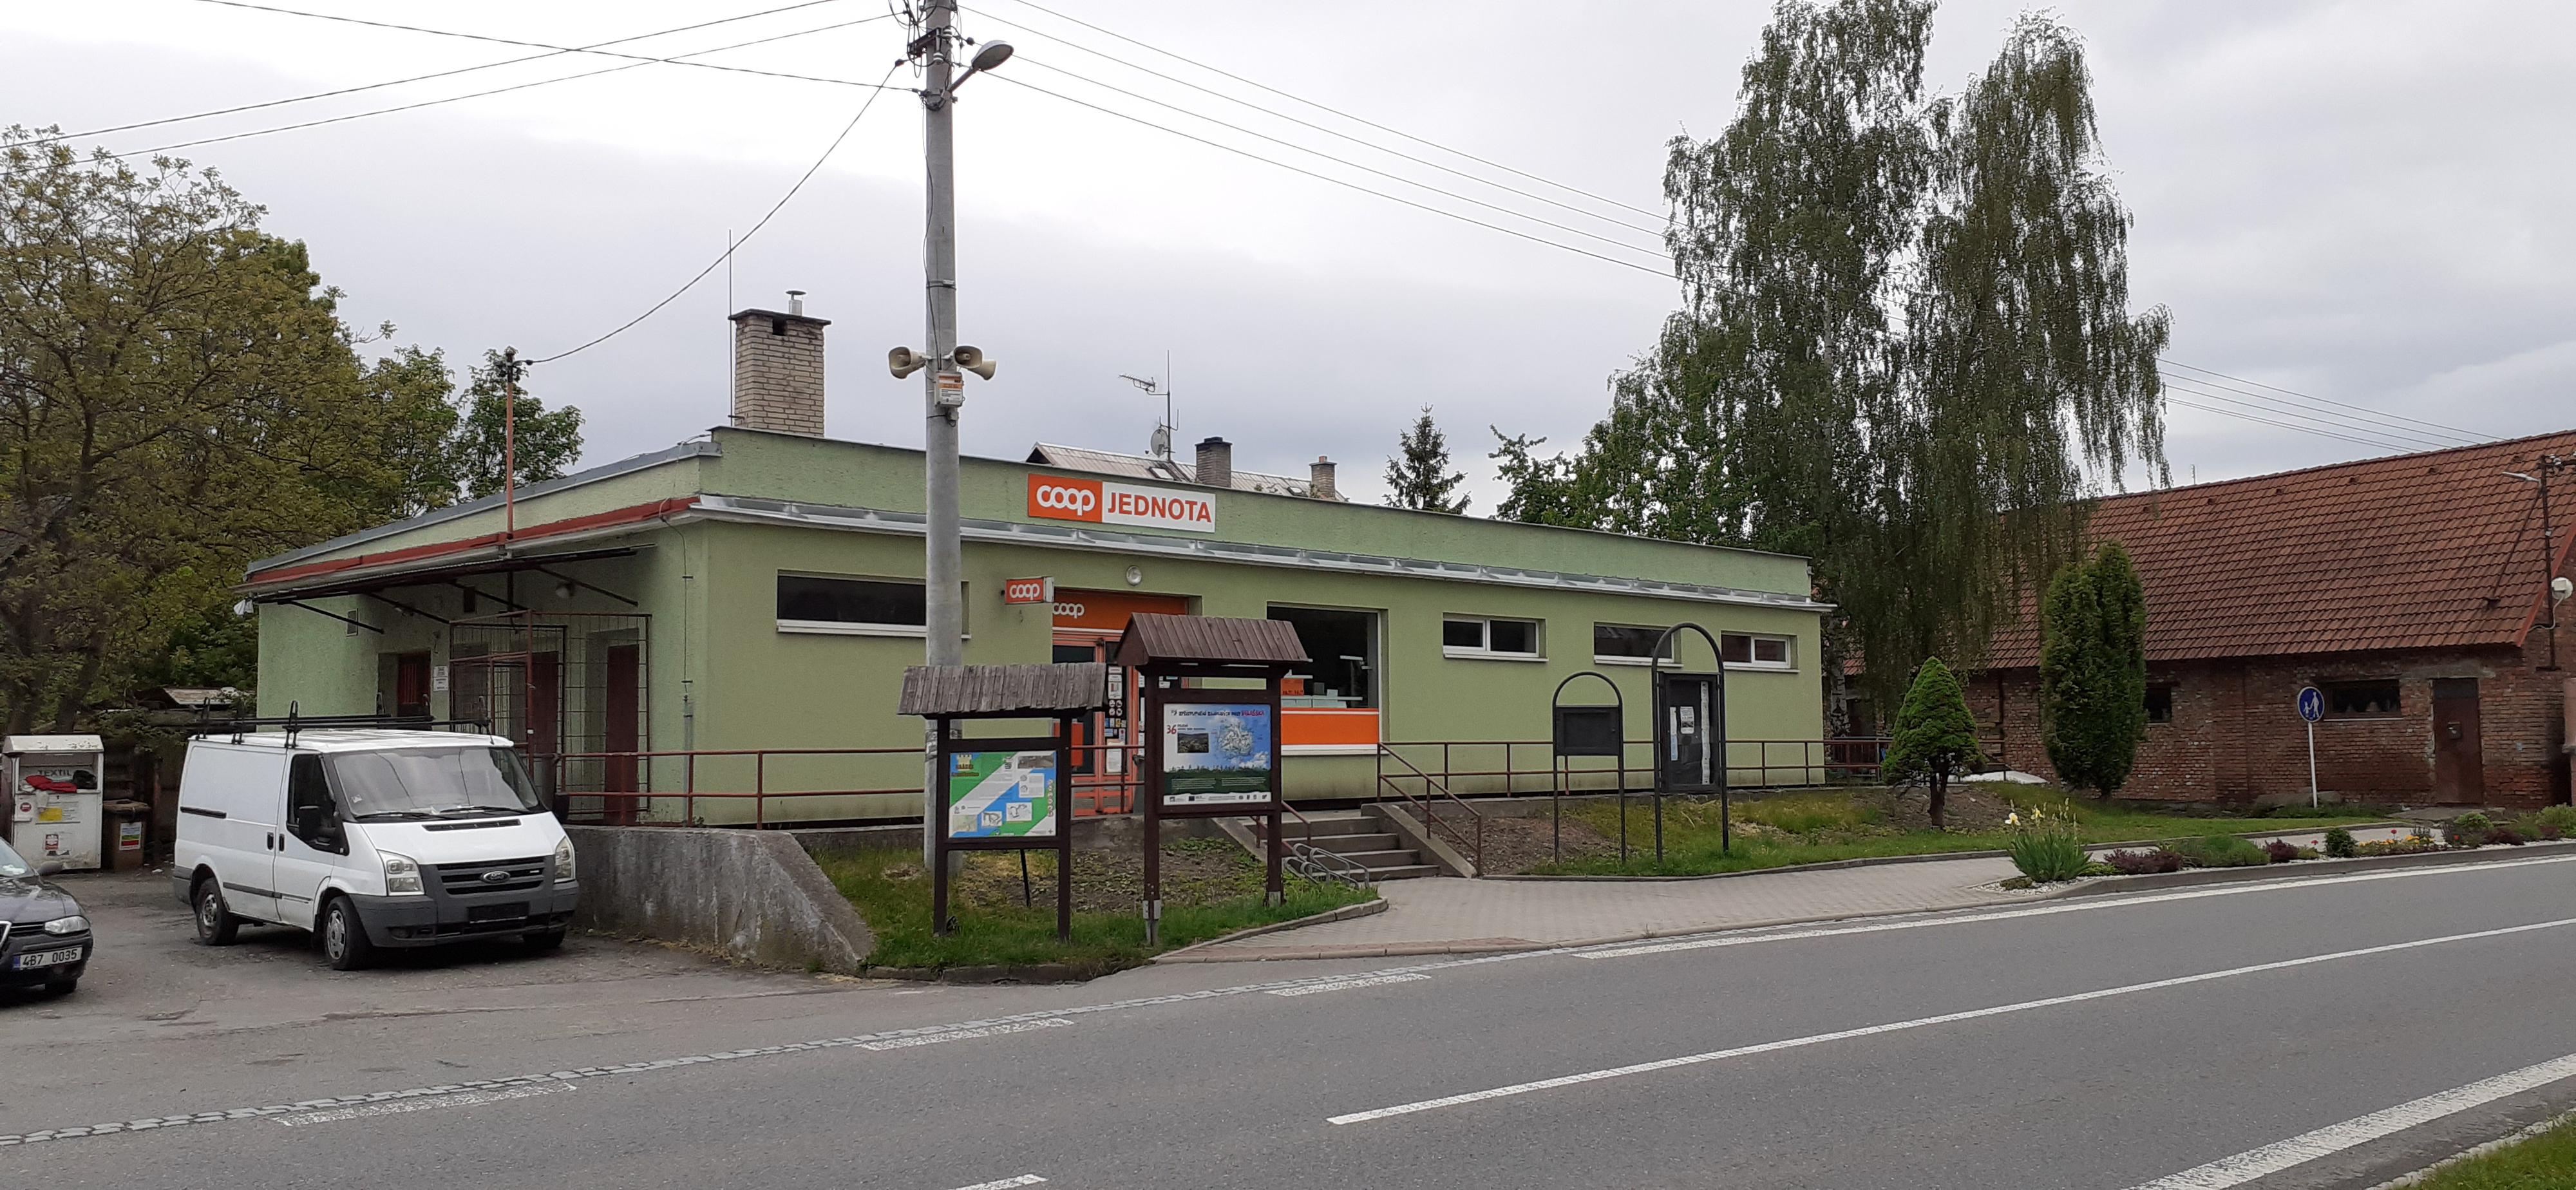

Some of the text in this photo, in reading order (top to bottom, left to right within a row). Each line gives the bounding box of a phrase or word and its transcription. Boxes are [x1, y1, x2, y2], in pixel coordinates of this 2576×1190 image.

[1036, 485, 1211, 523] coop JEDNOTA
[1010, 583, 1040, 601] coop
[1167, 724, 1177, 734] 36
[23, 949, 77, 966] 4B7 0035
